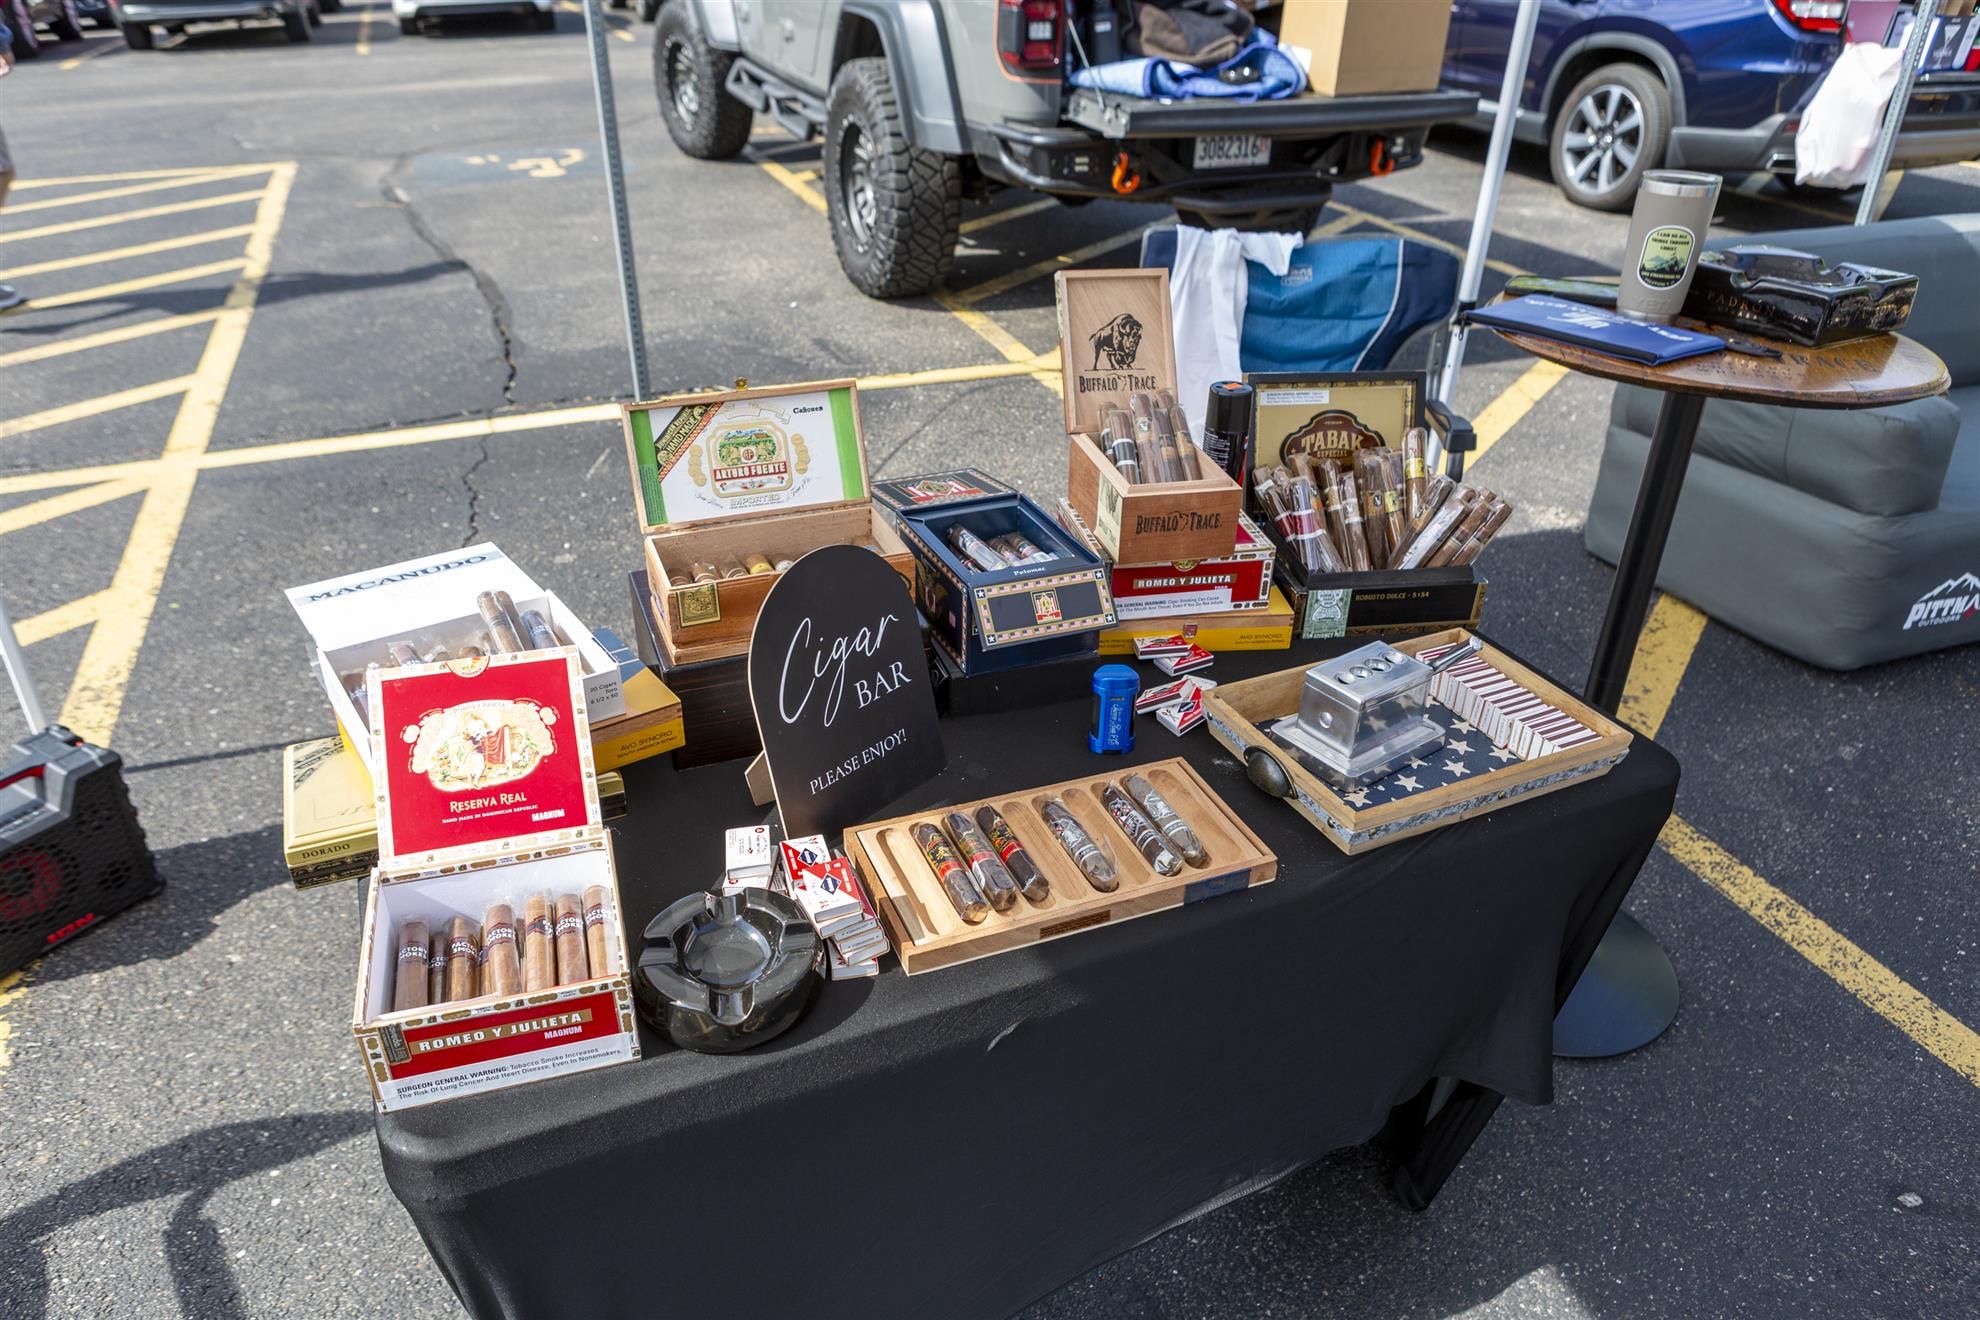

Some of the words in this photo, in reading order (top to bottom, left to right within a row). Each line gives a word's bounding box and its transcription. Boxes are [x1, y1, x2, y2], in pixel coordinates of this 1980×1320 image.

[1199, 137, 1259, 160] 3082316
[1079, 375, 1118, 393] BUFFALO
[1128, 374, 1156, 391] TRACE
[666, 433, 683, 453] HAND
[680, 416, 698, 437] MADE
[1301, 430, 1364, 455] TABAK
[715, 467, 750, 480] ARTURO
[751, 462, 786, 475] FUENTE
[730, 493, 780, 507] IMPORTED
[1136, 514, 1178, 534] BUFFALO
[1190, 512, 1220, 531] TRACE
[309, 556, 487, 602] MACANUDO
[1013, 566, 1046, 576] Potomac
[1138, 579, 1175, 588] ROMEO
[1180, 577, 1186, 586] Y
[1190, 575, 1231, 585] JULIETA
[1902, 593, 1980, 630] PITTMA
[779, 614, 899, 727] Cigar
[599, 681, 617, 690] Cigars
[854, 661, 912, 709] BAR
[621, 744, 637, 752] AVO
[638, 730, 673, 745] SYNCRO
[810, 755, 860, 795] PLEASE
[863, 728, 907, 765] ENJOY!
[450, 796, 497, 813] RESERVA
[500, 792, 527, 805] REAL
[532, 808, 565, 822] MAGNUM
[302, 843, 350, 859] DORADO
[420, 1031, 485, 1053] ROMEO
[492, 1027, 503, 1038] Y
[511, 1012, 582, 1034] JULIETA
[544, 1025, 582, 1040] MAGNUM
[397, 1081, 433, 1094] SURGEON
[435, 1075, 468, 1086] GENERAL
[469, 1066, 508, 1079] WARNING:
[511, 1060, 539, 1070] Tobacco
[541, 1055, 564, 1064] Smoke
[565, 1048, 598, 1059] Increases
[399, 1092, 412, 1100] The
[414, 1089, 428, 1097] Risk
[440, 1083, 458, 1091] Lung
[459, 1078, 484, 1088] Cancer
[485, 1074, 499, 1082] And
[522, 1065, 551, 1075] Disease,
[552, 1060, 569, 1068] Even
[578, 1049, 622, 1063] Nonsmokers.
